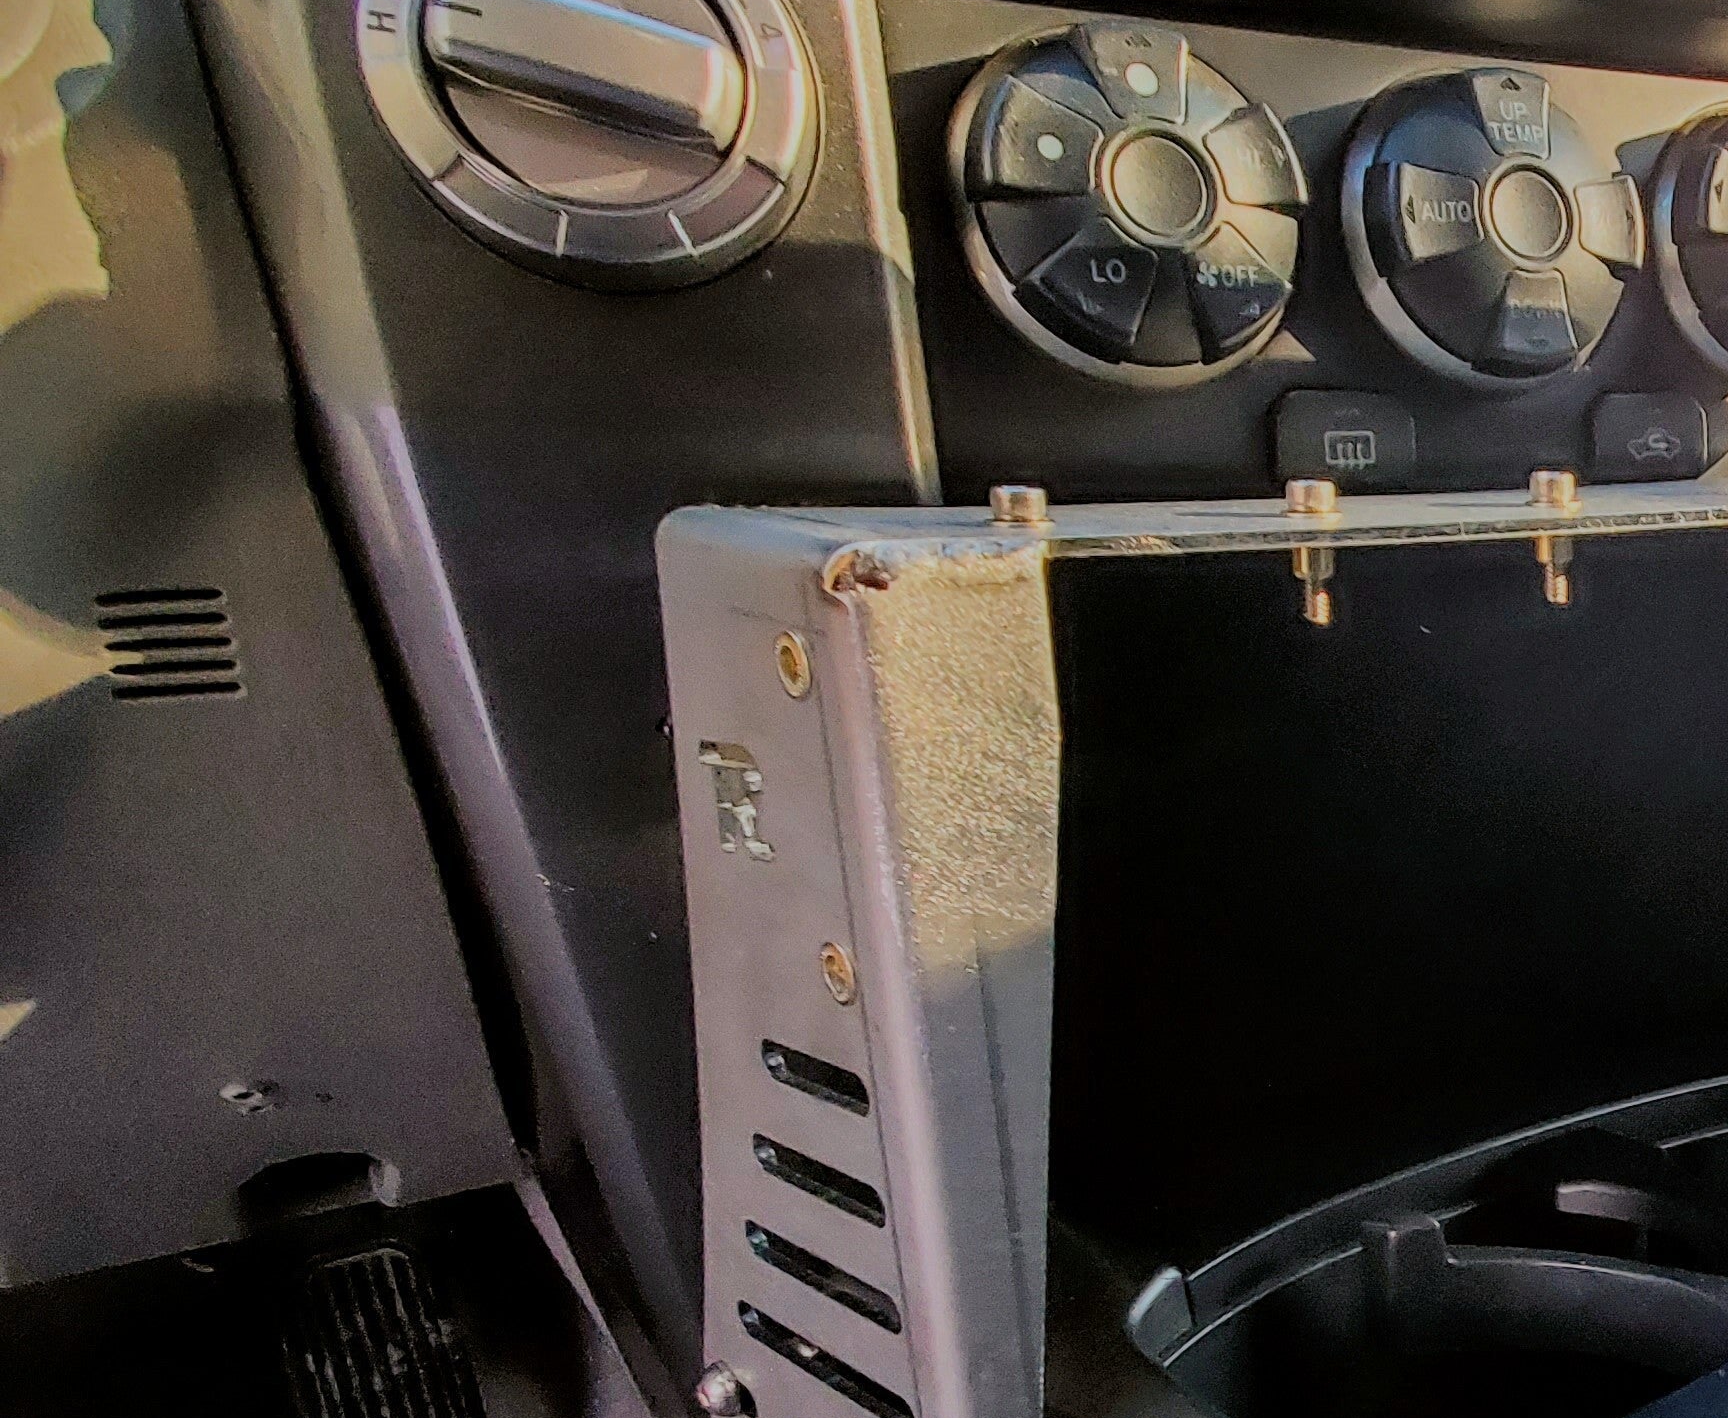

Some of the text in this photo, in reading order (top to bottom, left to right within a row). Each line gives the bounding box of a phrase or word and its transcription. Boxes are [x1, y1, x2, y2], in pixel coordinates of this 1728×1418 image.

[1498, 101, 1527, 122] UP
[1488, 121, 1545, 144] TEMP
[1420, 199, 1472, 224] AUTO
[1089, 259, 1127, 285] LO
[1222, 264, 1260, 288] OFF
